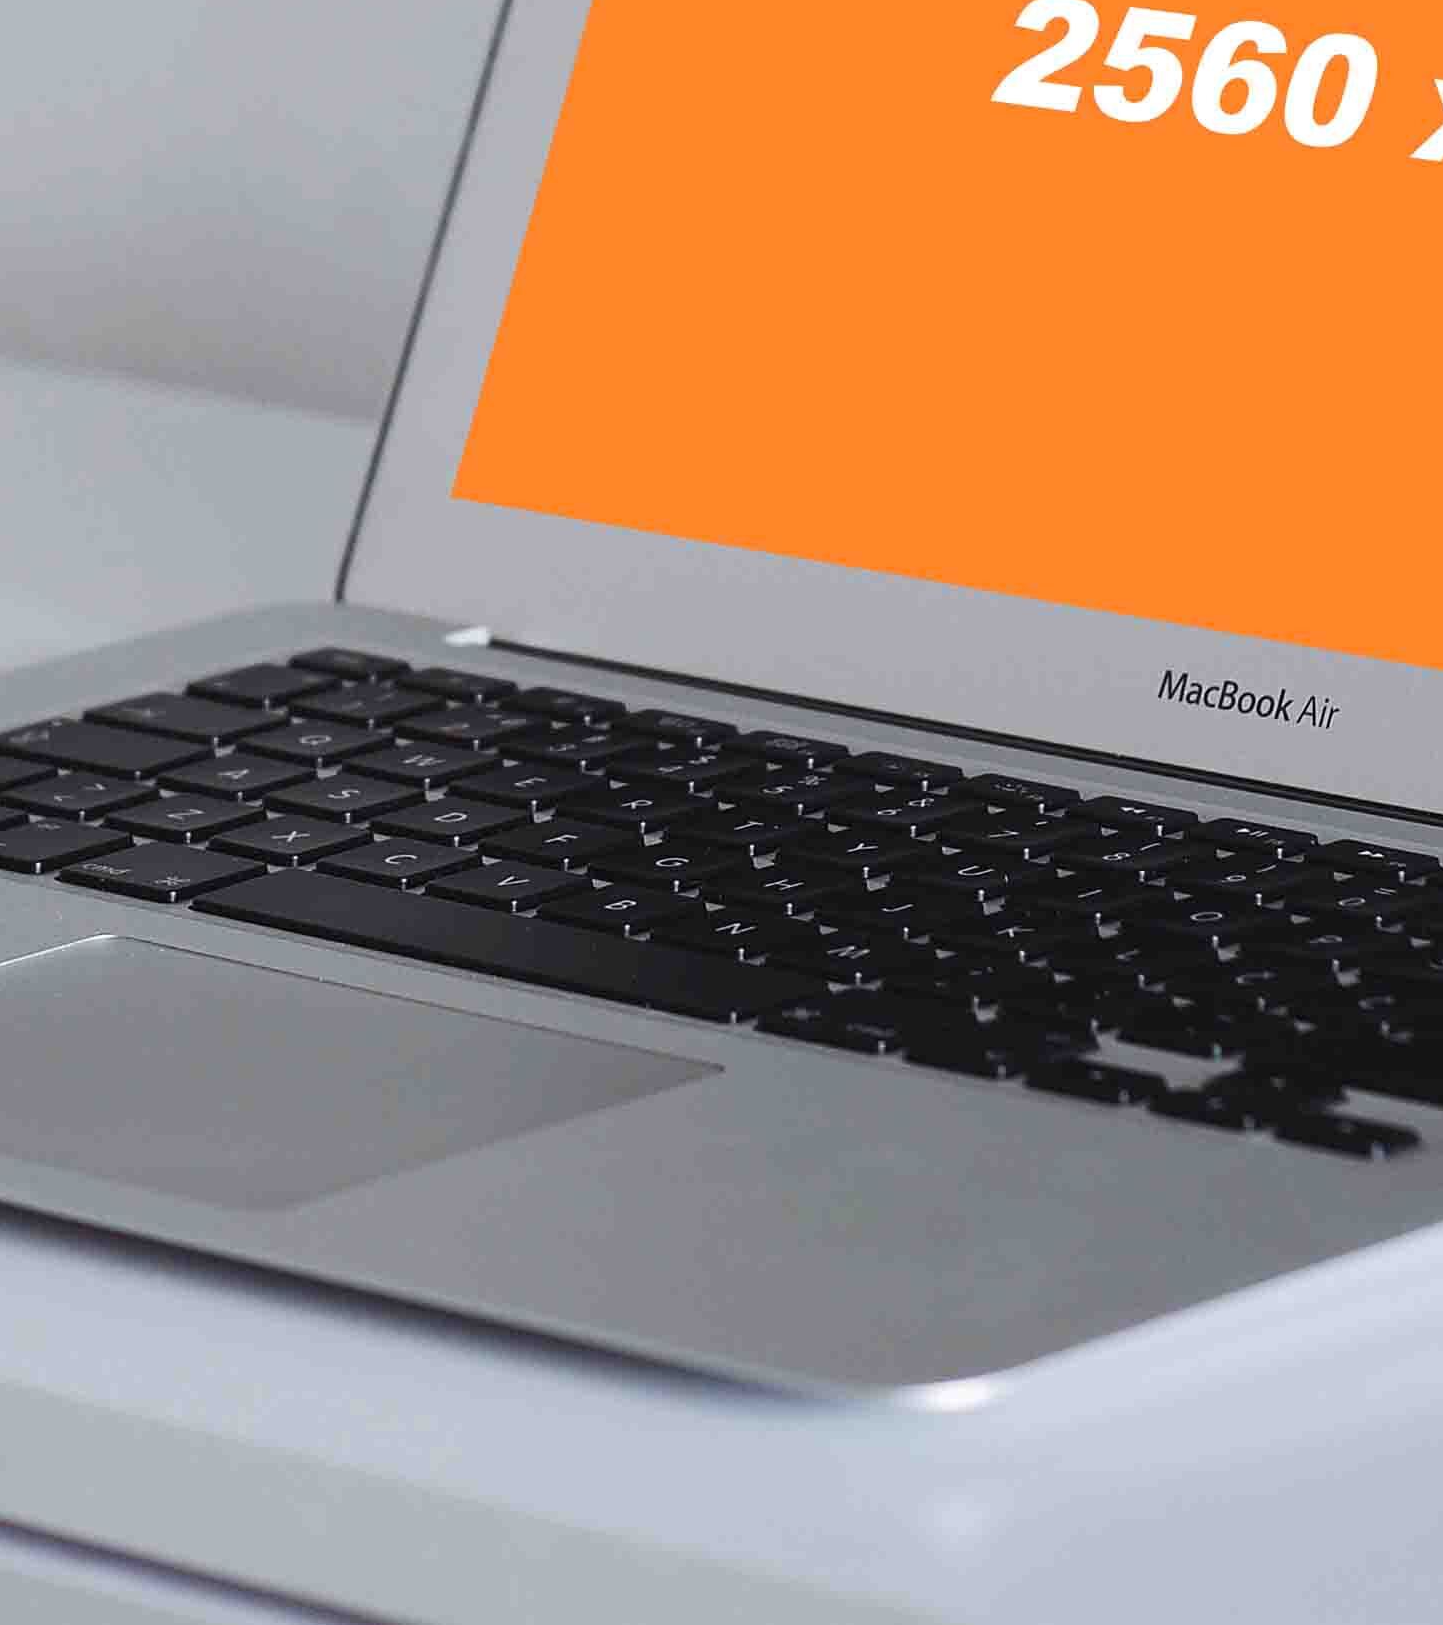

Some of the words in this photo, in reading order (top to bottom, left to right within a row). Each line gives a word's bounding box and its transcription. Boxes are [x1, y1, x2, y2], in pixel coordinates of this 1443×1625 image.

[1157, 670, 1294, 722] MacBook
[1296, 695, 1341, 730] Air
[433, 811, 468, 823] D
[271, 830, 311, 843] X
[543, 833, 580, 845] F
[383, 854, 418, 865] C
[957, 864, 997, 877] U
[495, 875, 532, 887] V
[762, 878, 806, 891] H
[603, 898, 638, 911] B
[714, 922, 758, 935] N
[826, 945, 871, 960] M
